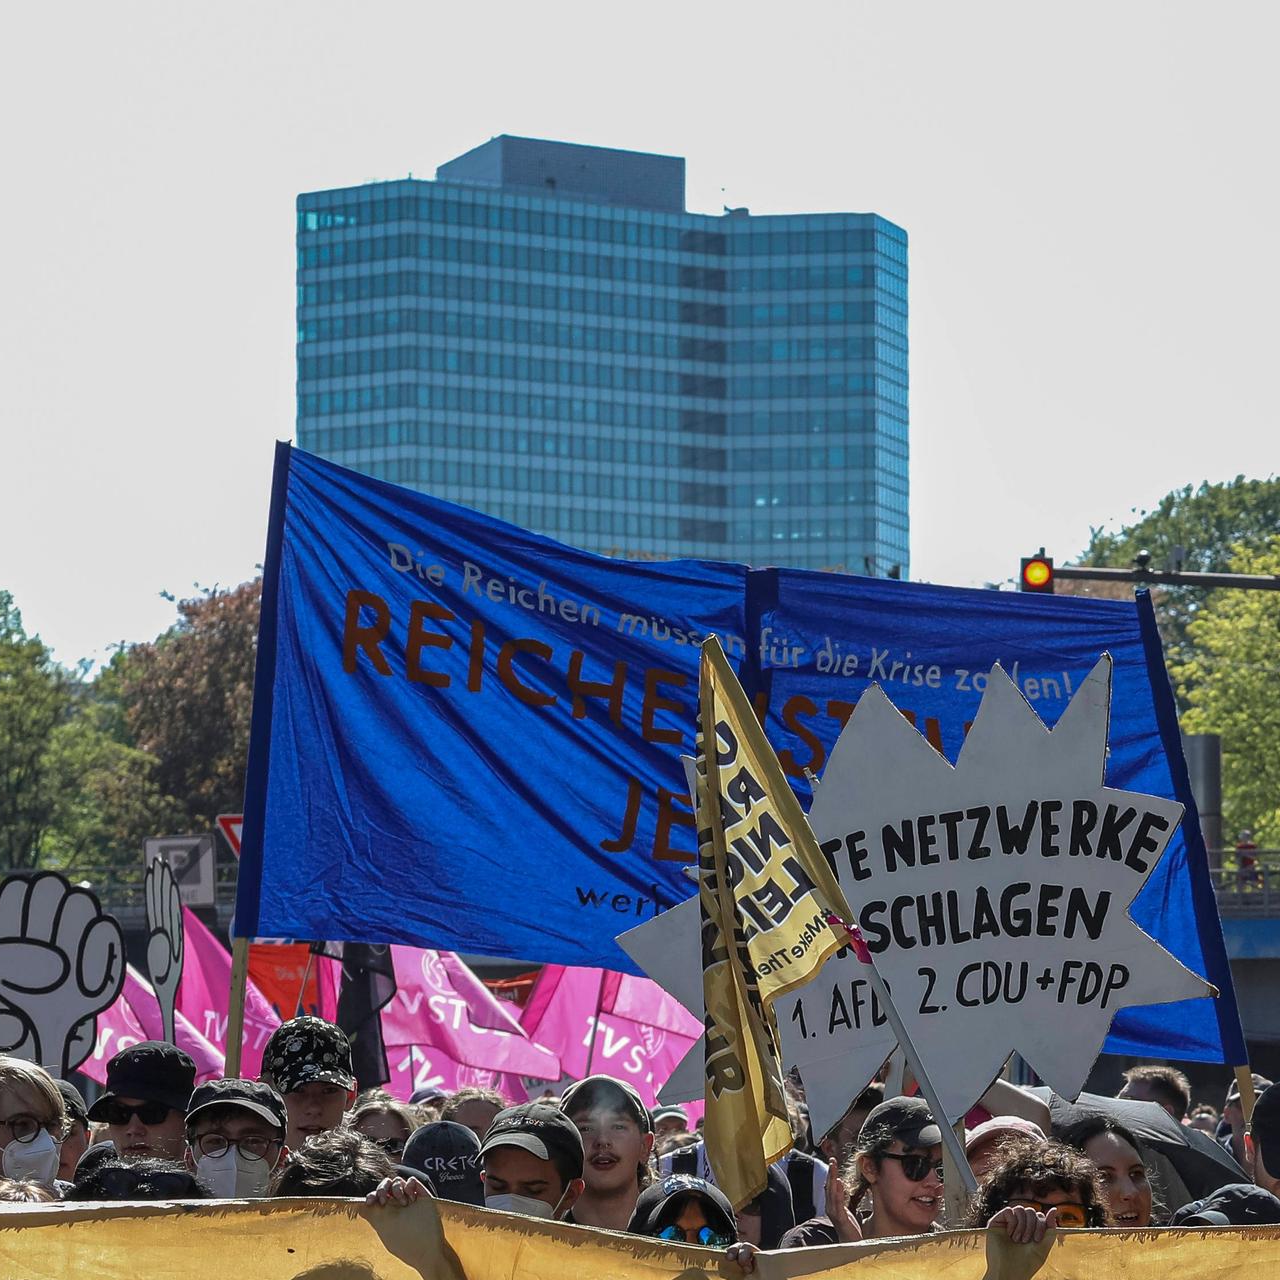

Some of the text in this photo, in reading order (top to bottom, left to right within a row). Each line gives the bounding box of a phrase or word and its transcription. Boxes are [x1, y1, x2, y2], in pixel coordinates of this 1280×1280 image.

[387, 543, 1073, 702] Die Reichen müssn für die Krise zalen!
[600, 776, 698, 864] JE
[882, 800, 1169, 874] NETZWERKE
[791, 997, 816, 1039] 1.
[917, 966, 948, 1014] 2.
[423, 1154, 476, 1172] CRETE
